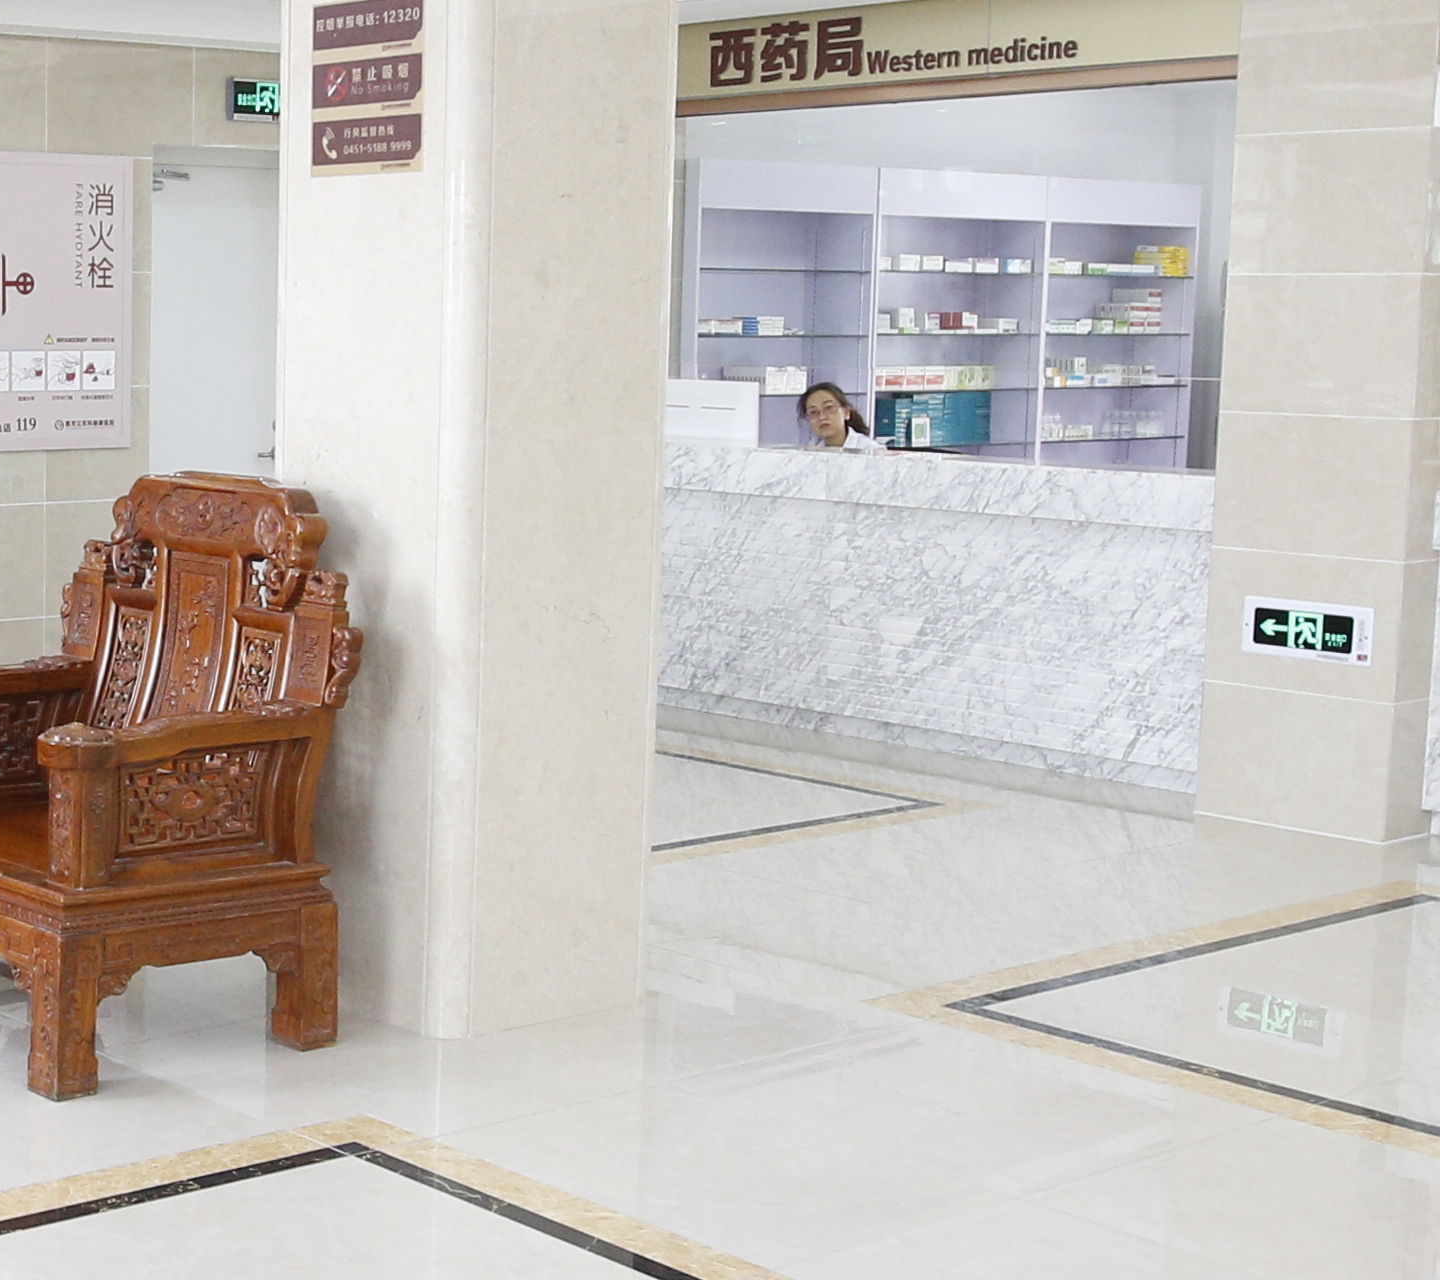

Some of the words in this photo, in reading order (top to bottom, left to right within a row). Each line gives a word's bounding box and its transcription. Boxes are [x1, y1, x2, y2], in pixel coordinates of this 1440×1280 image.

[382, 6, 420, 24] 12320
[709, 16, 864, 88] 西药局
[866, 48, 960, 74] Western
[967, 35, 1078, 66] medicine
[352, 62, 409, 83] 禁止吸烟
[351, 85, 364, 95] No
[367, 81, 409, 94] Smoking
[389, 140, 412, 152] 9999
[74, 182, 84, 217] FARE
[87, 182, 115, 290] 消火栓
[74, 222, 84, 288] HYDTANT
[16, 417, 37, 432] 119
